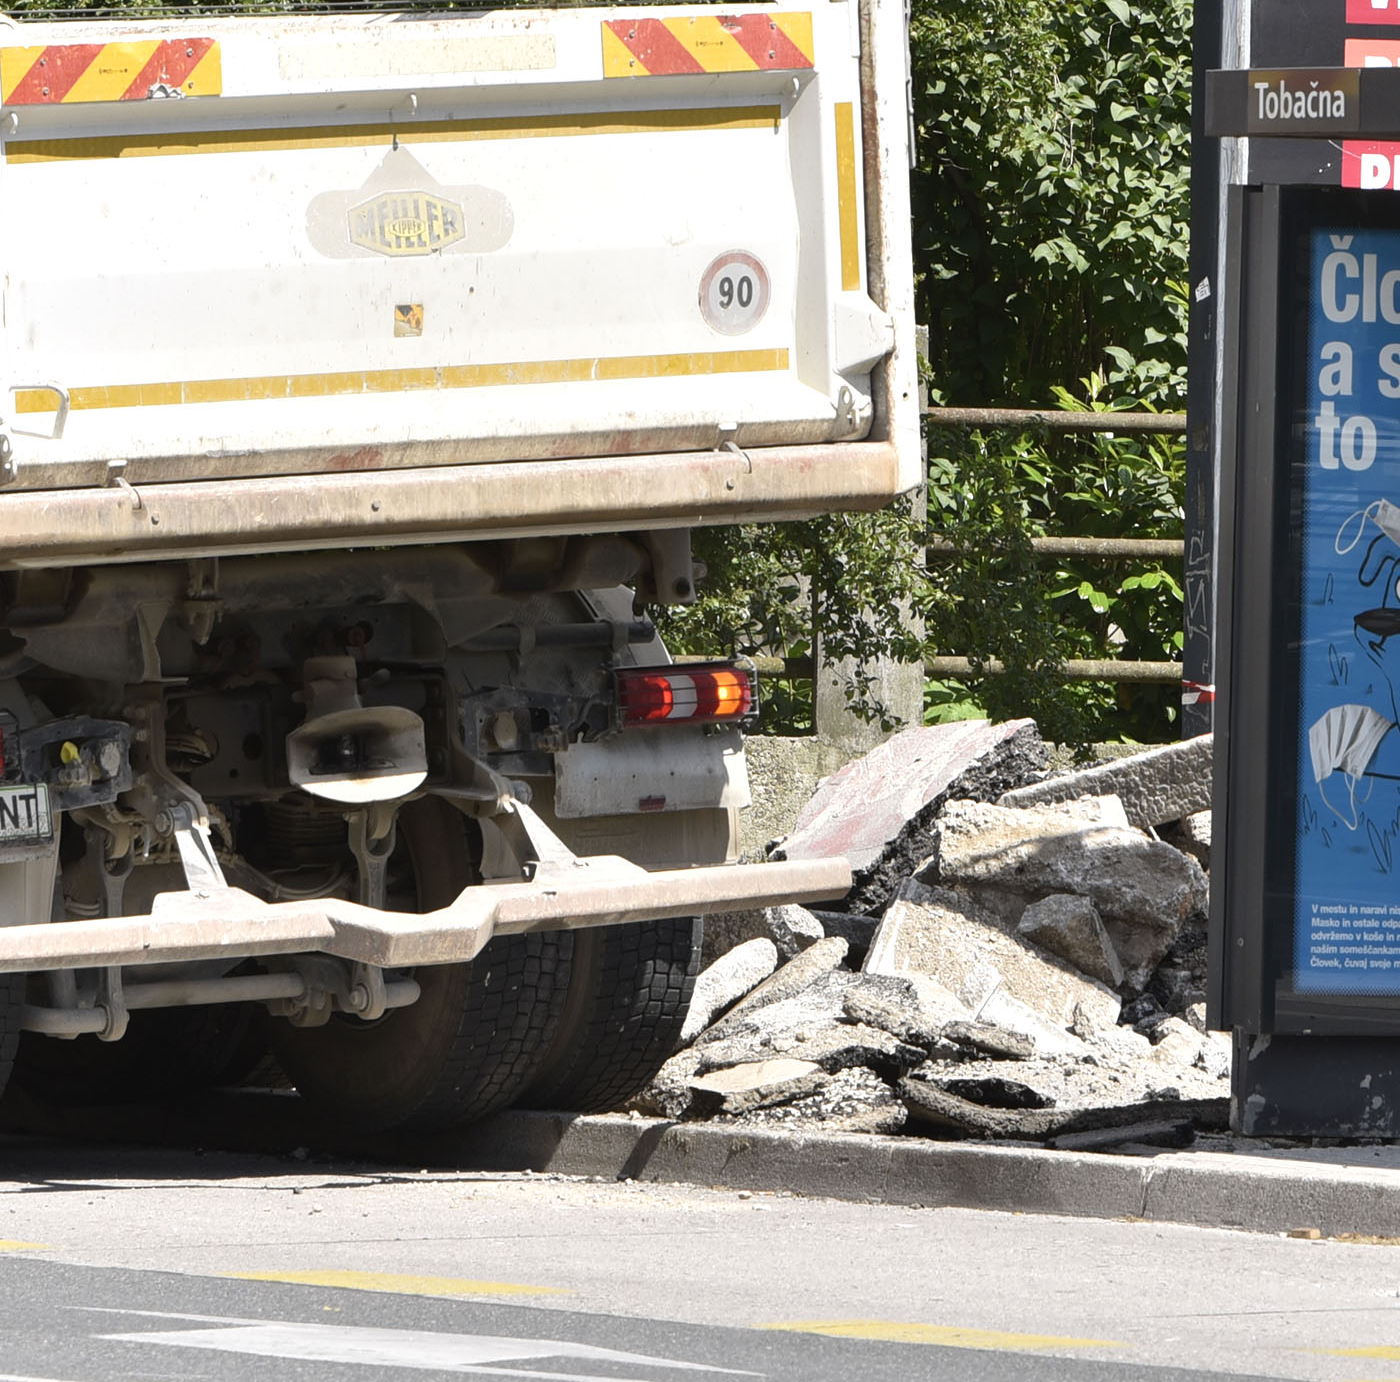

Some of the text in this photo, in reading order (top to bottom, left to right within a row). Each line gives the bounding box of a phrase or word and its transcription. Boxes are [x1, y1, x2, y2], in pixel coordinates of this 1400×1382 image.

[1254, 79, 1345, 120] Tobačna
[355, 196, 458, 250] MEILLER
[719, 275, 753, 310] 90
[1318, 341, 1353, 396] a
[1315, 400, 1377, 472] to
[1311, 904, 1319, 915] V
[1320, 905, 1348, 915] mestu
[1349, 904, 1359, 915] in
[1360, 905, 1387, 915] naravi
[1311, 918, 1341, 928] Masko
[1342, 918, 1351, 928] in
[1353, 918, 1380, 929] ostale
[1311, 931, 1354, 941] odvržemo
[1363, 931, 1385, 942] koše
[1386, 932, 1395, 942] in
[1310, 944, 1338, 954] našim
[1339, 944, 1400, 955] someščankam
[1310, 957, 1342, 969] Človek,
[1344, 958, 1368, 969] čuvaj
[1369, 959, 1392, 969] svoje
